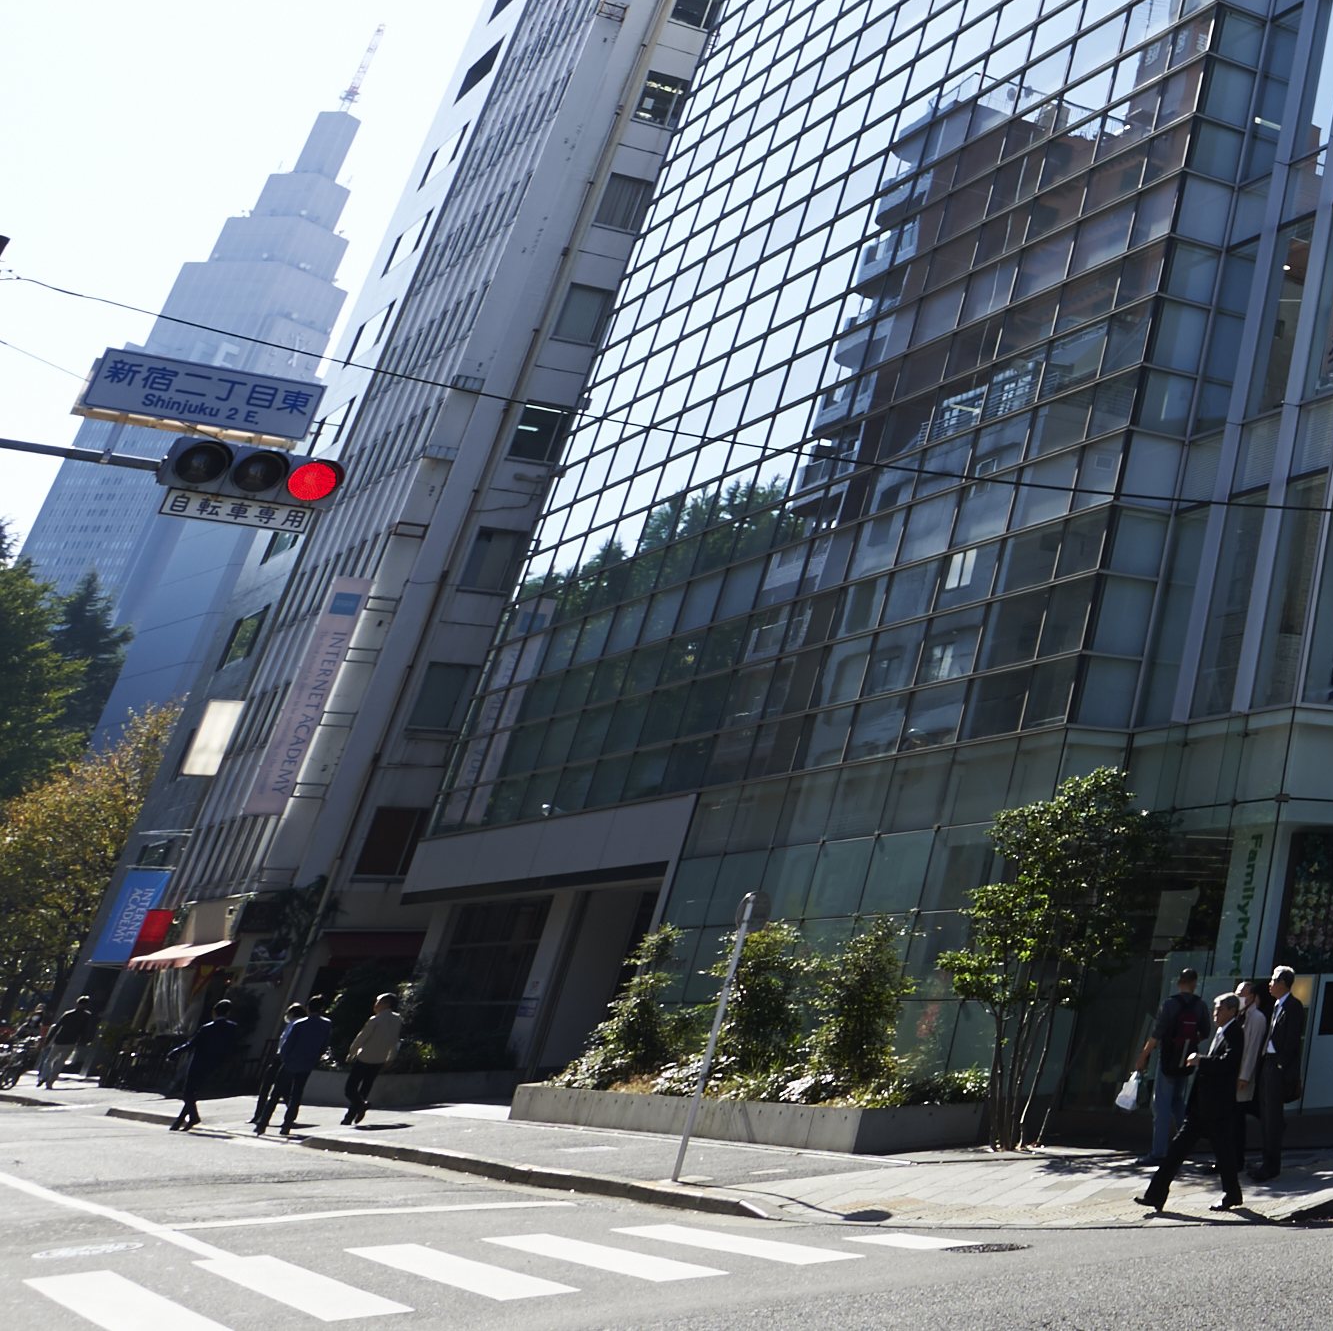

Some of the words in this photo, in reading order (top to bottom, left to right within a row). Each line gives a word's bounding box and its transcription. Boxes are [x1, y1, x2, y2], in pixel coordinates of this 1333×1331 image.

[104, 359, 314, 416] 新宿二丁目東
[142, 394, 220, 418] Shinjuku
[226, 407, 239, 420] 2
[169, 494, 306, 529] 自転車専用
[304, 632, 347, 710] INTERNET
[272, 713, 314, 795] ACADEMY
[112, 887, 143, 944] ACADEMY
[124, 888, 151, 944] INTERNET
